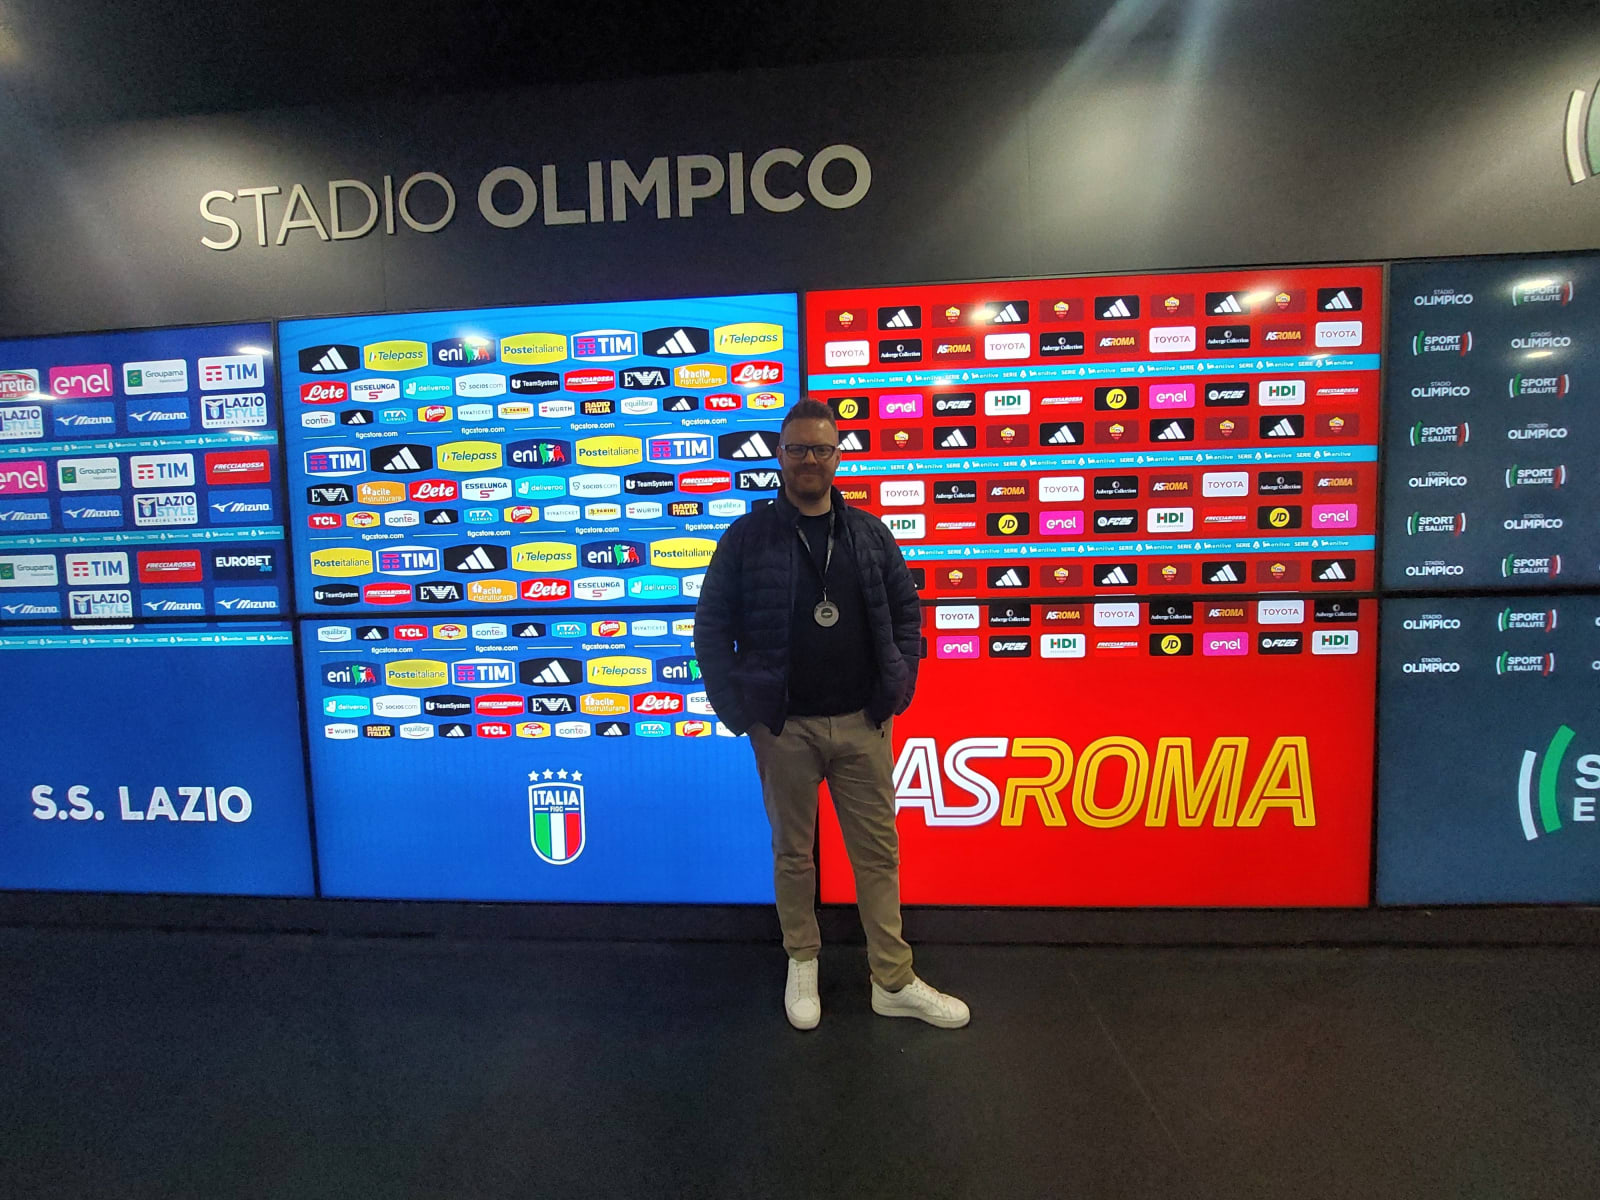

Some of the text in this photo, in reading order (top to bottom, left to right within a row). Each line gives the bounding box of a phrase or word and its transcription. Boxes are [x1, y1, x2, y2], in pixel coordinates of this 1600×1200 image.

[200, 144, 872, 250] STADIO OLIMPICO
[1414, 294, 1473, 306] OLIMPICO
[729, 333, 778, 344] Telepass
[1154, 335, 1190, 344] TOYOTA
[1320, 330, 1356, 339] TOYOTA
[1424, 335, 1460, 345] SPORT
[1511, 337, 1571, 348] OLIMPICO
[598, 337, 631, 354] TIM
[990, 342, 1025, 351] TOYOTA
[378, 350, 423, 361] Telepass
[438, 344, 462, 360] eni
[830, 350, 864, 358] TOYOTA
[145, 369, 184, 378] Groupama
[225, 364, 258, 380] TIM
[735, 365, 778, 381] Lete
[54, 375, 110, 394] enel
[469, 382, 503, 390] socios.com
[522, 376, 558, 387] TeamSystem
[1521, 378, 1557, 387] SPORT
[354, 383, 396, 391] ESSELUNGA
[418, 384, 450, 392] deliveroo
[1269, 386, 1296, 397] HDI
[1411, 386, 1470, 397] OLIMPICO
[304, 386, 344, 400] Lete
[1110, 393, 1123, 403] JD
[1157, 391, 1187, 402] enel
[224, 397, 264, 408] LAZIO
[710, 398, 735, 407] TCL
[995, 395, 1021, 406] HDI
[842, 404, 855, 413] JD
[886, 400, 916, 413] enel
[2, 410, 39, 420] LAZIO
[225, 407, 264, 418] STYLE
[383, 410, 407, 418] ITA
[4, 421, 41, 430] STYLE
[461, 426, 505, 435] figcstore.com
[571, 421, 615, 430] figcstore.com
[1422, 426, 1457, 435] SPORT
[355, 431, 398, 439] figcstore.com
[1508, 428, 1567, 439] OLIMPICO
[673, 440, 707, 456] TIM
[451, 451, 497, 462] Telepass
[513, 446, 537, 462] eni
[329, 454, 361, 469] TIM
[80, 467, 116, 475] Groupama
[156, 463, 188, 479] TIM
[1517, 469, 1553, 477] SPORT
[637, 479, 673, 488] TeamSystem
[1208, 481, 1244, 489] TOYOTA
[1409, 476, 1467, 488] OLIMPICO
[413, 483, 454, 498] Lete
[885, 489, 919, 497] TOYOTA
[156, 496, 194, 506] LAZIO
[157, 506, 195, 516] STYLE
[1319, 510, 1349, 522] enel
[313, 517, 336, 525] TCL
[1047, 517, 1076, 529] enel
[1157, 513, 1183, 523] HDI
[1419, 516, 1454, 525] SPORT
[890, 520, 916, 530] HDI
[1002, 519, 1015, 529] JD
[1425, 524, 1454, 532] SALUTE
[1504, 519, 1563, 529] OLIMPICO
[575, 526, 619, 534] figcstore.com
[526, 550, 572, 562] Telepass
[587, 546, 612, 563] eni
[216, 556, 270, 568] EUROBET
[402, 553, 434, 568] TIM
[1514, 558, 1549, 567] SPORT
[17, 564, 54, 572] Groupama
[91, 561, 122, 576] TIM
[1406, 566, 1463, 576] OLIMPICO
[524, 582, 566, 598] Lete
[644, 583, 676, 591] deliveroo
[91, 594, 129, 603] LAZIO
[93, 603, 129, 613] STYLE
[940, 613, 974, 621] TOYOTA
[1509, 613, 1545, 621] SPORT
[1403, 619, 1460, 629] OLIMPICO
[399, 628, 423, 637] TCL
[1050, 639, 1076, 649] HDI
[1210, 638, 1240, 650] enel
[1322, 635, 1348, 645] HDI
[943, 641, 972, 653] enel
[1508, 656, 1543, 665] SPORT
[477, 666, 509, 680] TIM
[601, 666, 647, 677] Telepass
[662, 664, 687, 678] eni
[1403, 663, 1460, 673] OLIMPICO
[327, 666, 350, 683] eni
[386, 702, 417, 710] socios.com
[436, 702, 470, 710] TeamSystem
[637, 695, 679, 710] Lete
[482, 726, 506, 734] TCL
[533, 790, 579, 805] ITALIA
[31, 785, 252, 822] S.S. LAZIO
